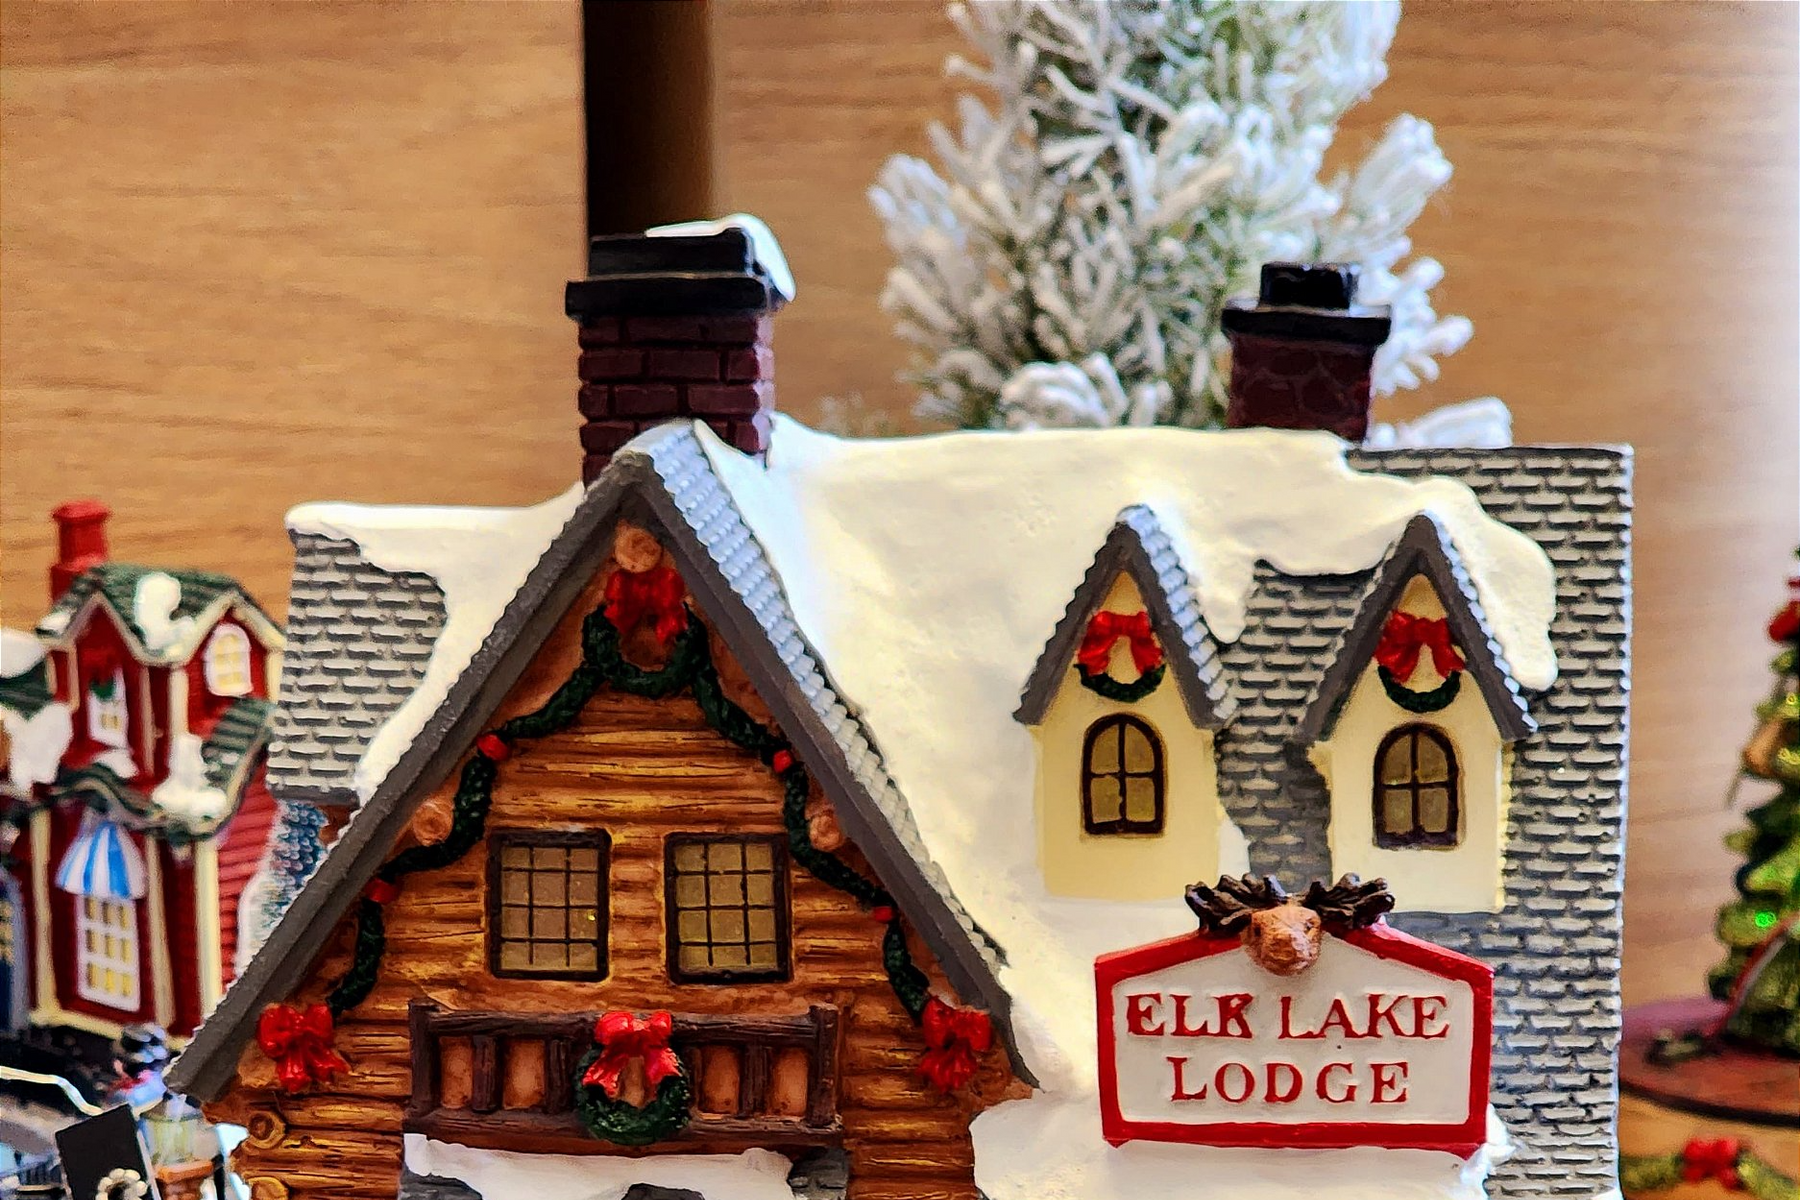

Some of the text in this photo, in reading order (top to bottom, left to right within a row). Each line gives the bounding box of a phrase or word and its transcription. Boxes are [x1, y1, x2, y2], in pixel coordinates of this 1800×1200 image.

[1126, 992, 1451, 1040] ELK LAKE
[1166, 1056, 1409, 1104] LODGE
